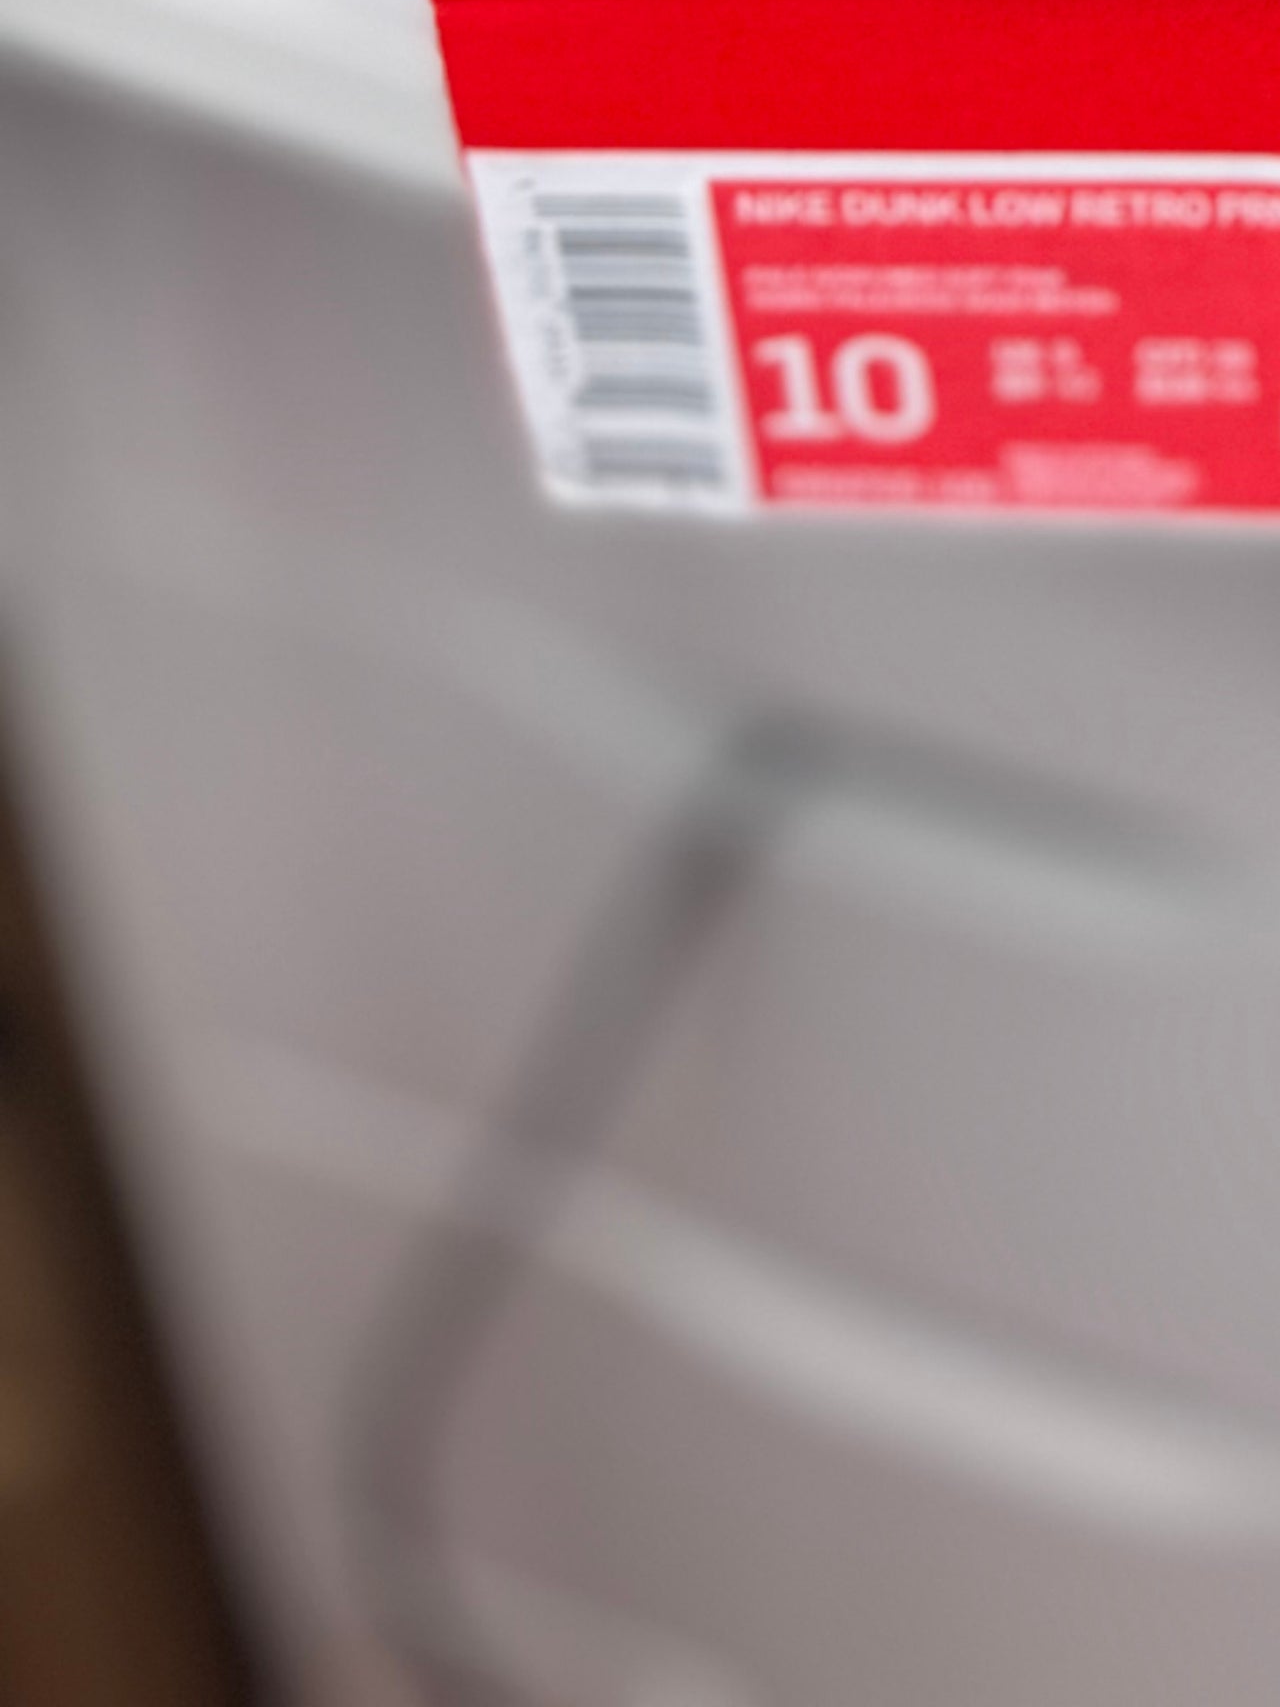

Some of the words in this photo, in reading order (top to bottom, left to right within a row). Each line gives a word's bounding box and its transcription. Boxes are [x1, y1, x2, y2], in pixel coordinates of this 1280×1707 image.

[735, 191, 834, 227] NIKE
[841, 191, 965, 227] DUNK
[969, 191, 1067, 228] LOW
[1071, 192, 1211, 229] RETRO
[750, 332, 938, 442] 10
